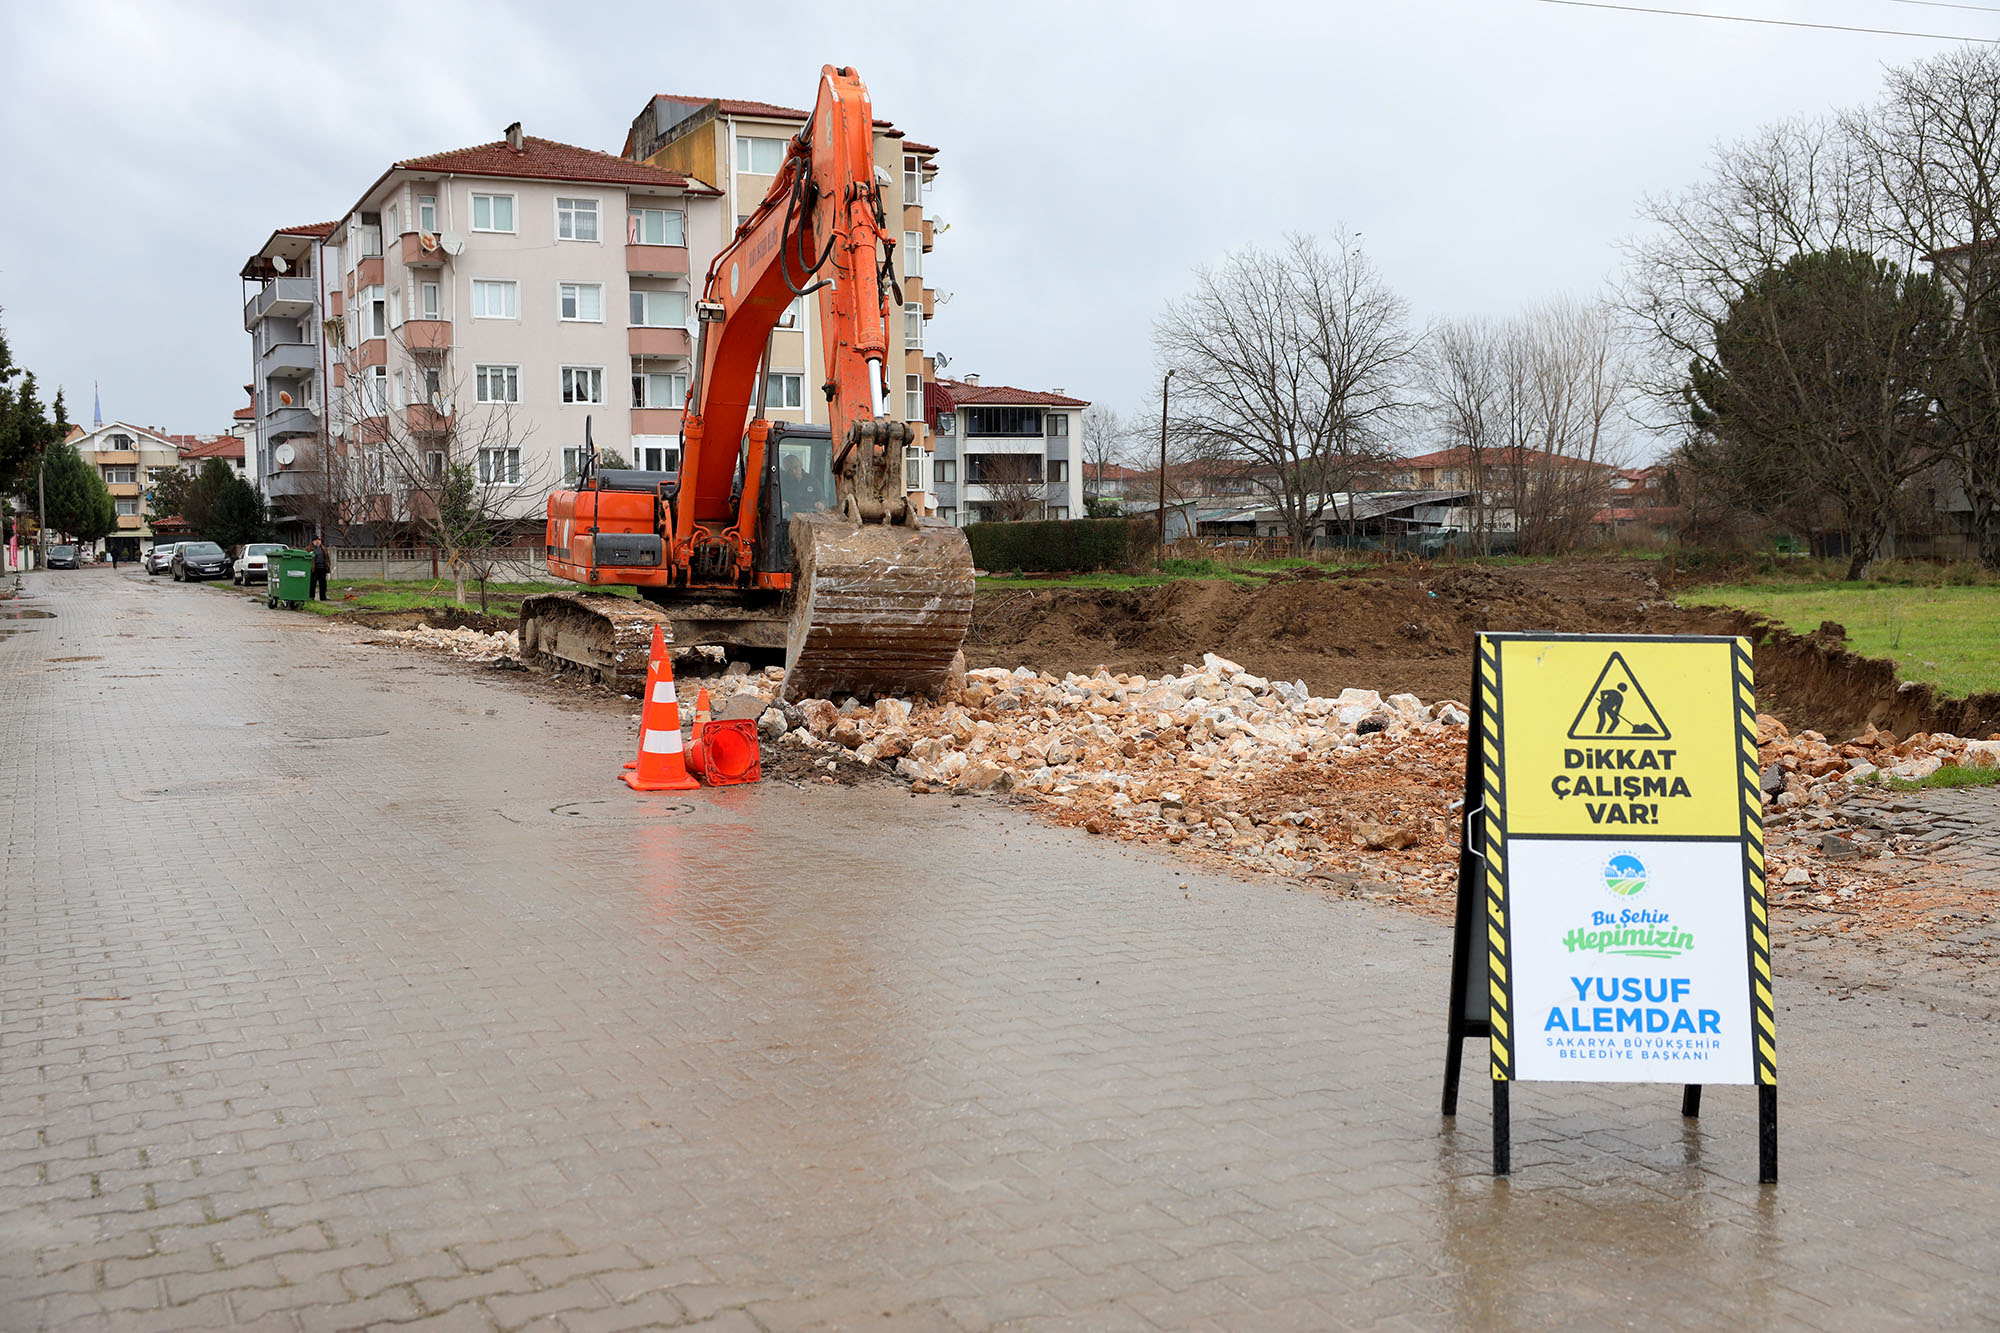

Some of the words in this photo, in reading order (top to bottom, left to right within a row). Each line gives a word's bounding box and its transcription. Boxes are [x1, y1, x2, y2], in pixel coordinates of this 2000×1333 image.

[1551, 775, 1692, 801] ÇALIŞMA
[1585, 803, 1659, 824] VAR!
[1591, 910, 1616, 926] Bu
[1620, 908, 1669, 928] Şehir
[1562, 923, 1695, 953] Hepimizin
[1570, 976, 1691, 1003] YUSUF
[1544, 1006, 1722, 1034] ALEMDAR
[1546, 1037, 1616, 1048] SAKARYA
[1624, 1037, 1721, 1050] BÜYÜKŞEHİR
[1559, 1048, 1633, 1060] BELEDİYE
[1641, 1050, 1709, 1061] BAŞKANI
